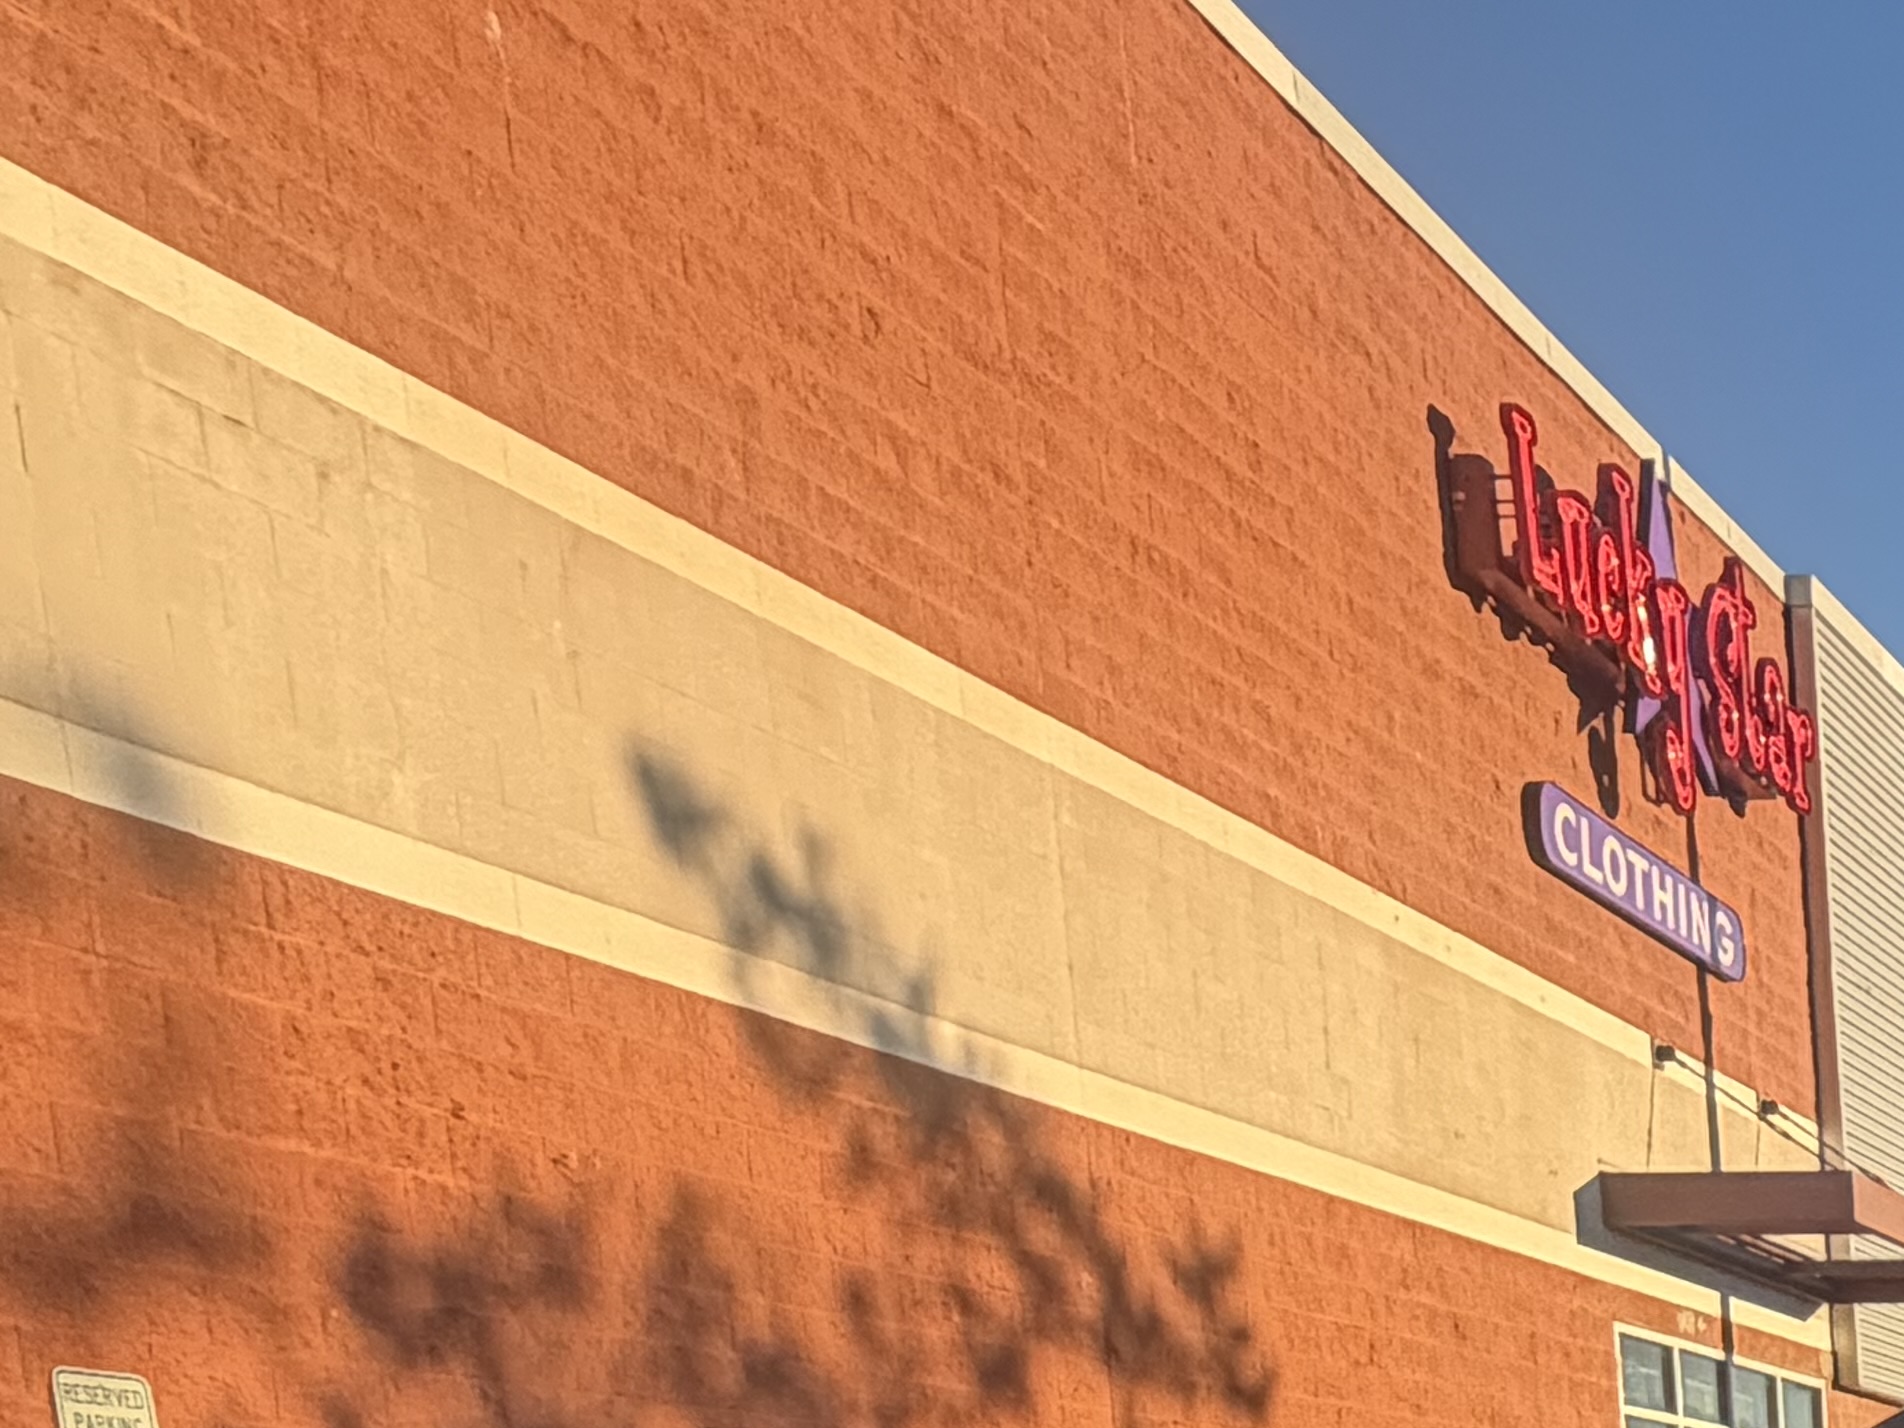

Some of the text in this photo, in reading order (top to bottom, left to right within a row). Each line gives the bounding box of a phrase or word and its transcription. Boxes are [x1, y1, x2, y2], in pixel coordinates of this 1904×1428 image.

[1501, 404, 1816, 815] Lucky Star
[1552, 802, 1737, 969] CLOTHING
[62, 1382, 145, 1411] RESERVED
